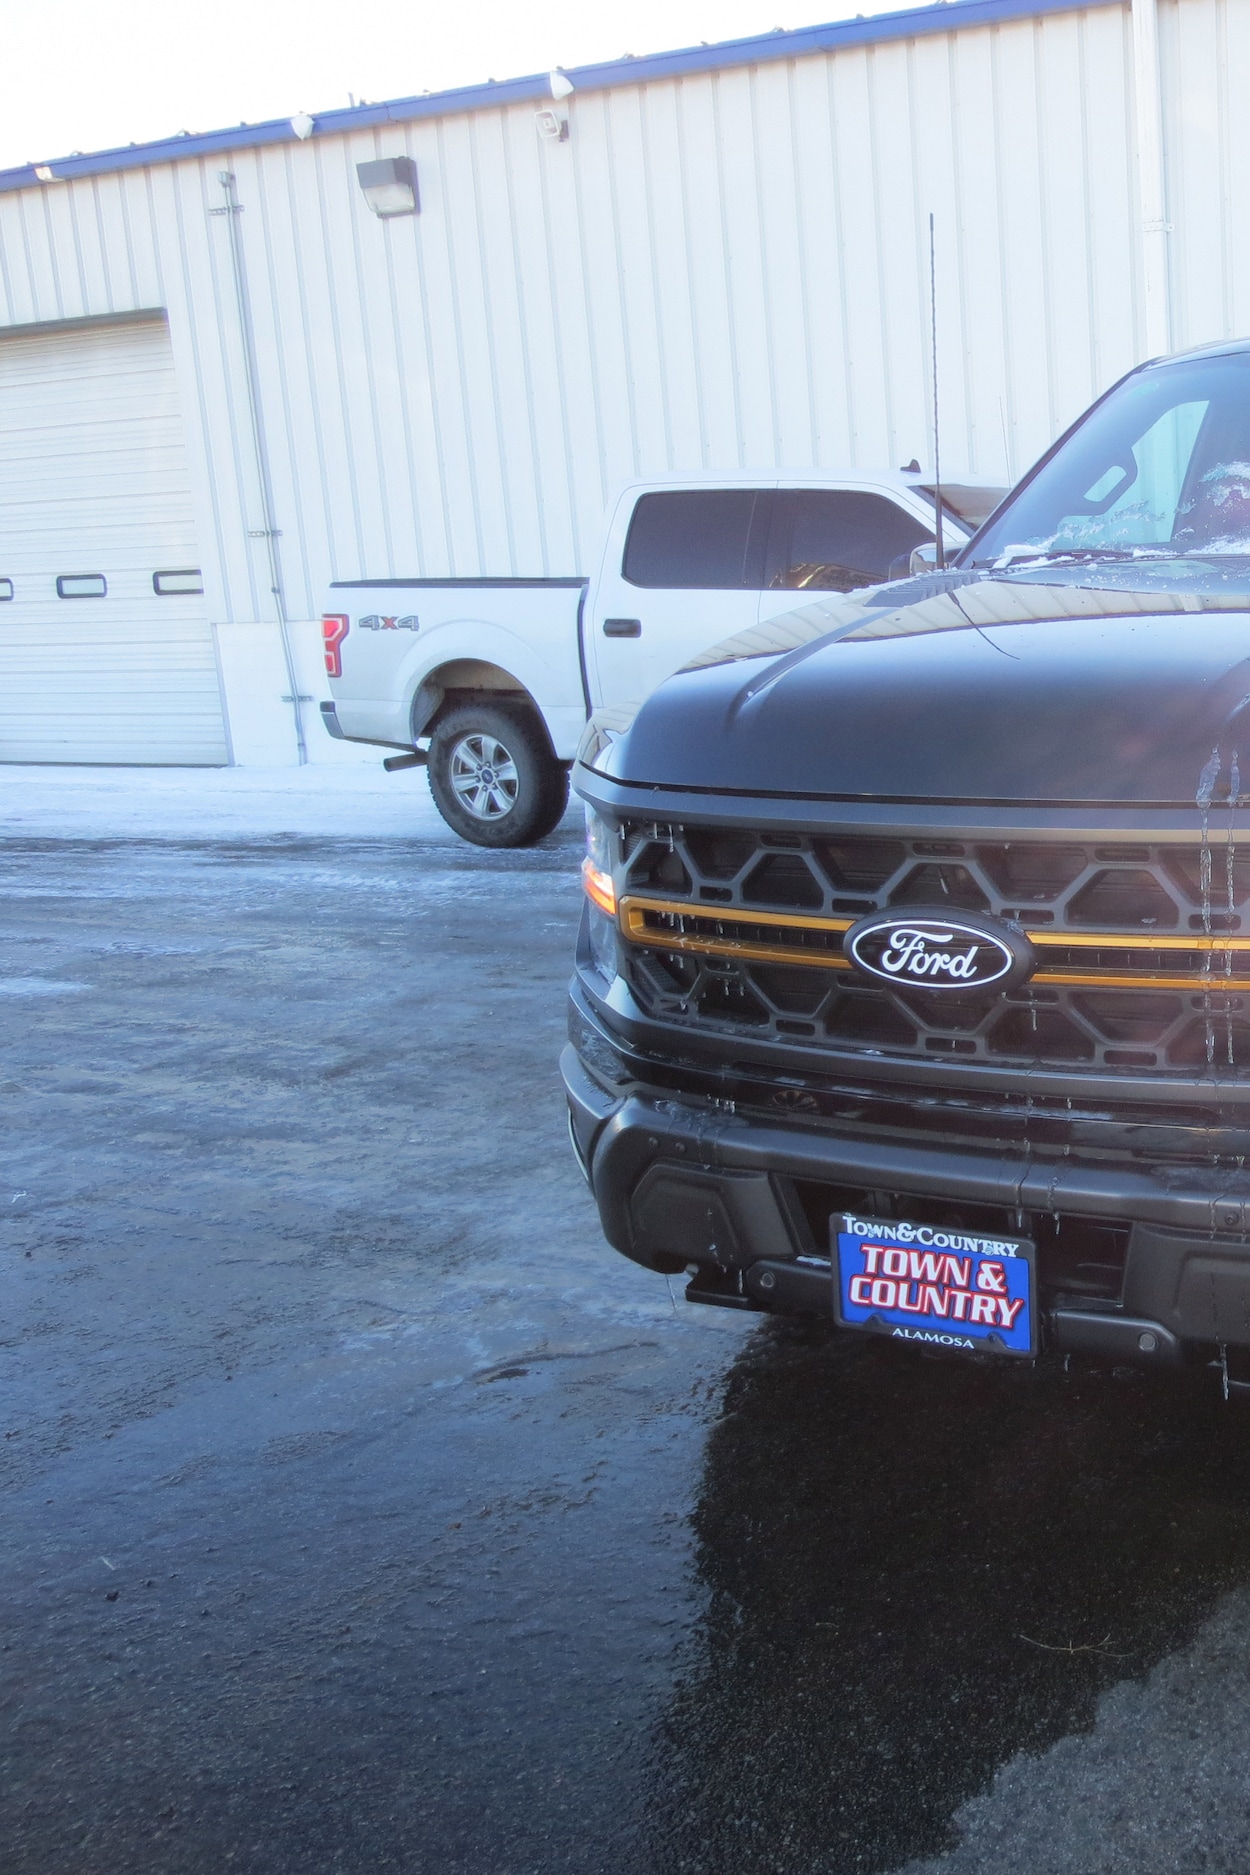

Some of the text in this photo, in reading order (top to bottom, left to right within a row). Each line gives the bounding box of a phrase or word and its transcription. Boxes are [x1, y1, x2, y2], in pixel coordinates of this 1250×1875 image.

[881, 928, 979, 978] Ford
[860, 1243, 1008, 1294] TOWN &
[850, 1274, 1025, 1329] COUNTRY
[891, 1327, 976, 1350] ALAMOSA
